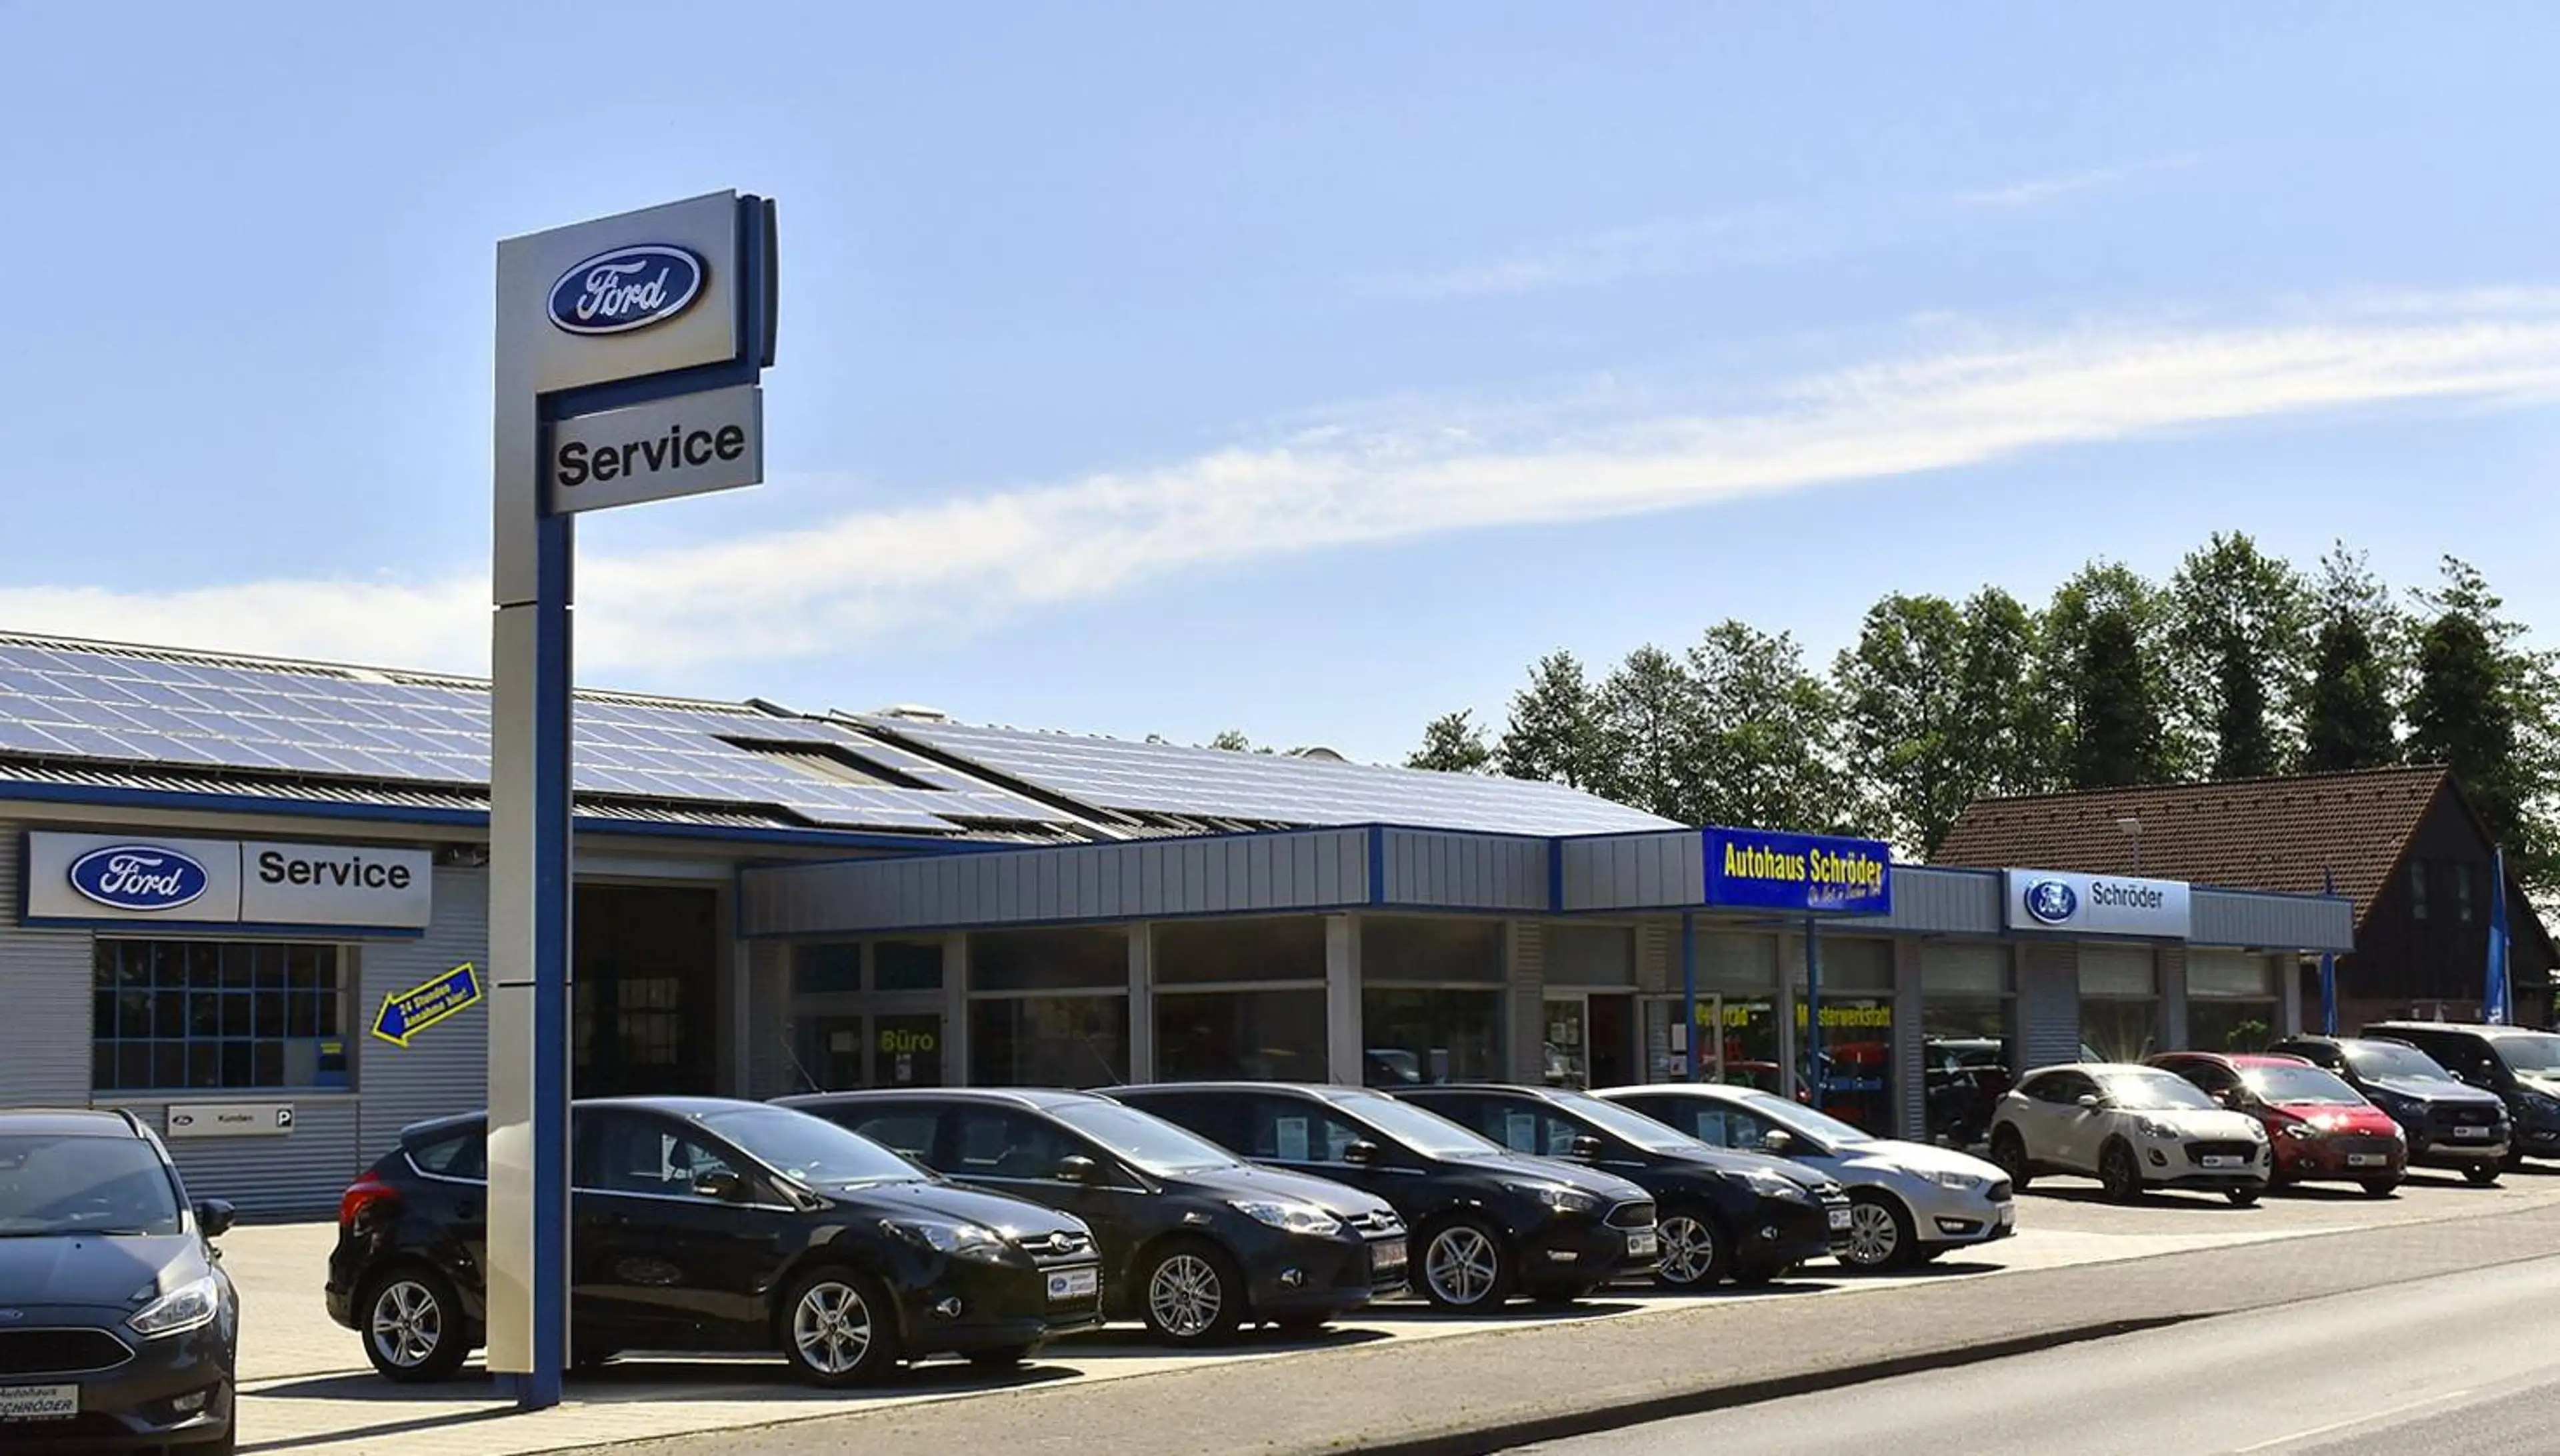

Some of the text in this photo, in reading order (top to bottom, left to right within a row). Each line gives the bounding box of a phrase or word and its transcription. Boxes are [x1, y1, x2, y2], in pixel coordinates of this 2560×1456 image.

[577, 259, 670, 321] Ford
[557, 425, 745, 487] Service
[98, 850, 411, 897] Ford Service
[1724, 842, 1883, 887] Autohaus Schröder
[2091, 881, 2164, 909] Schröder
[881, 1029, 934, 1053] Büro
